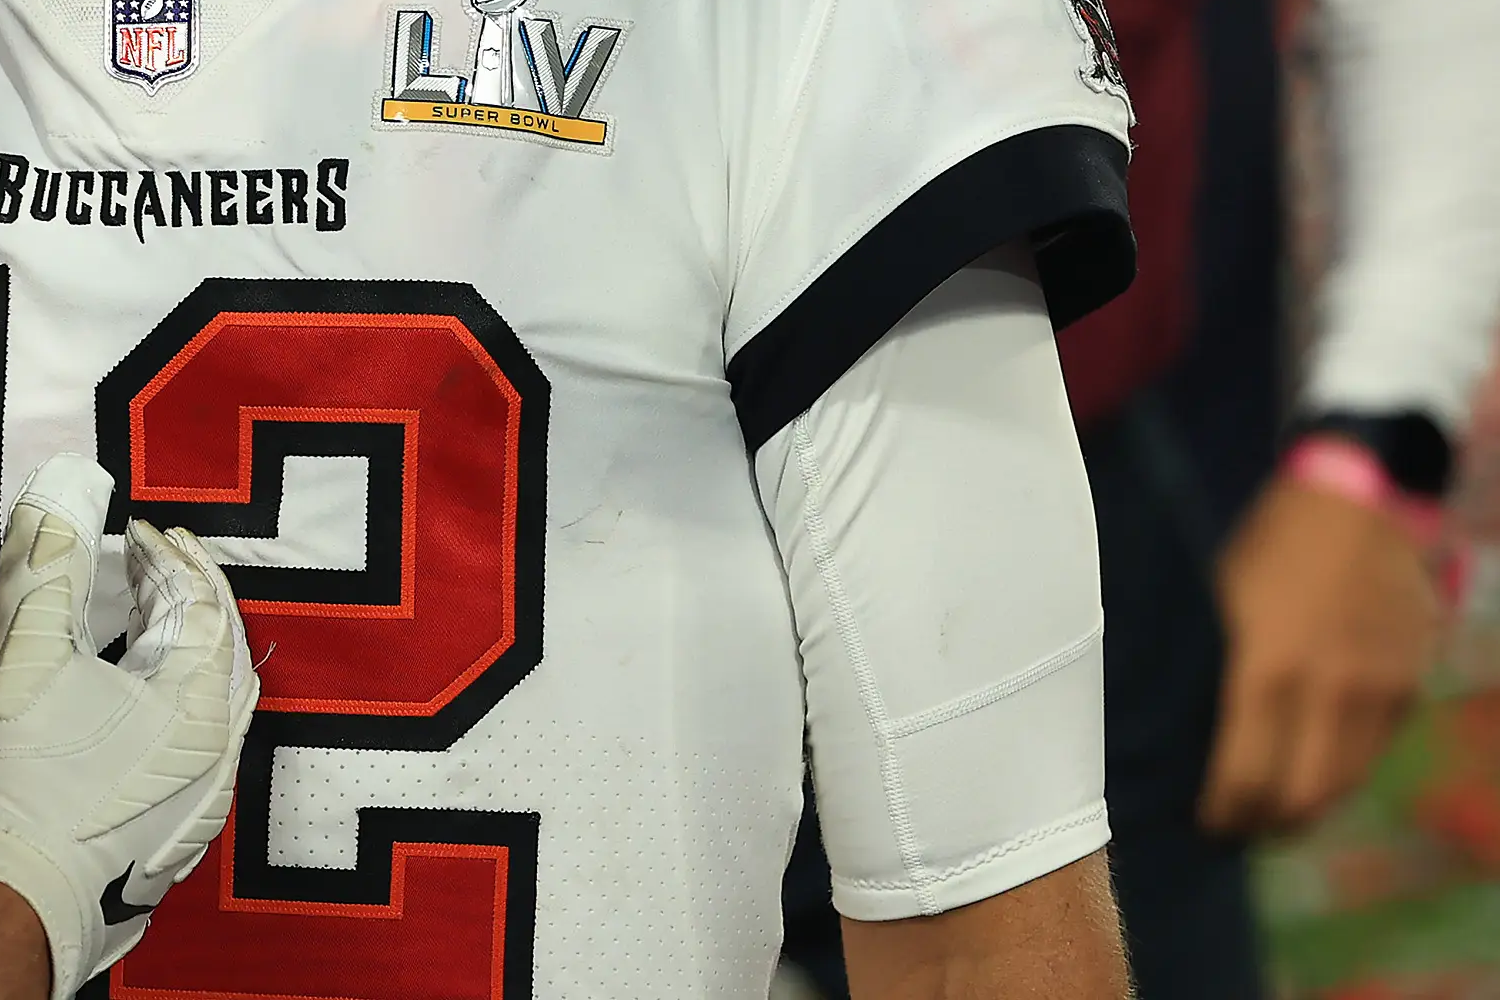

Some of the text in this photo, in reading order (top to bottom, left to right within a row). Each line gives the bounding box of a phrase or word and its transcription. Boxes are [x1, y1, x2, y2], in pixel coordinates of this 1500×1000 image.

[119, 25, 185, 72] NFL
[431, 105, 560, 132] SUPER BOWL
